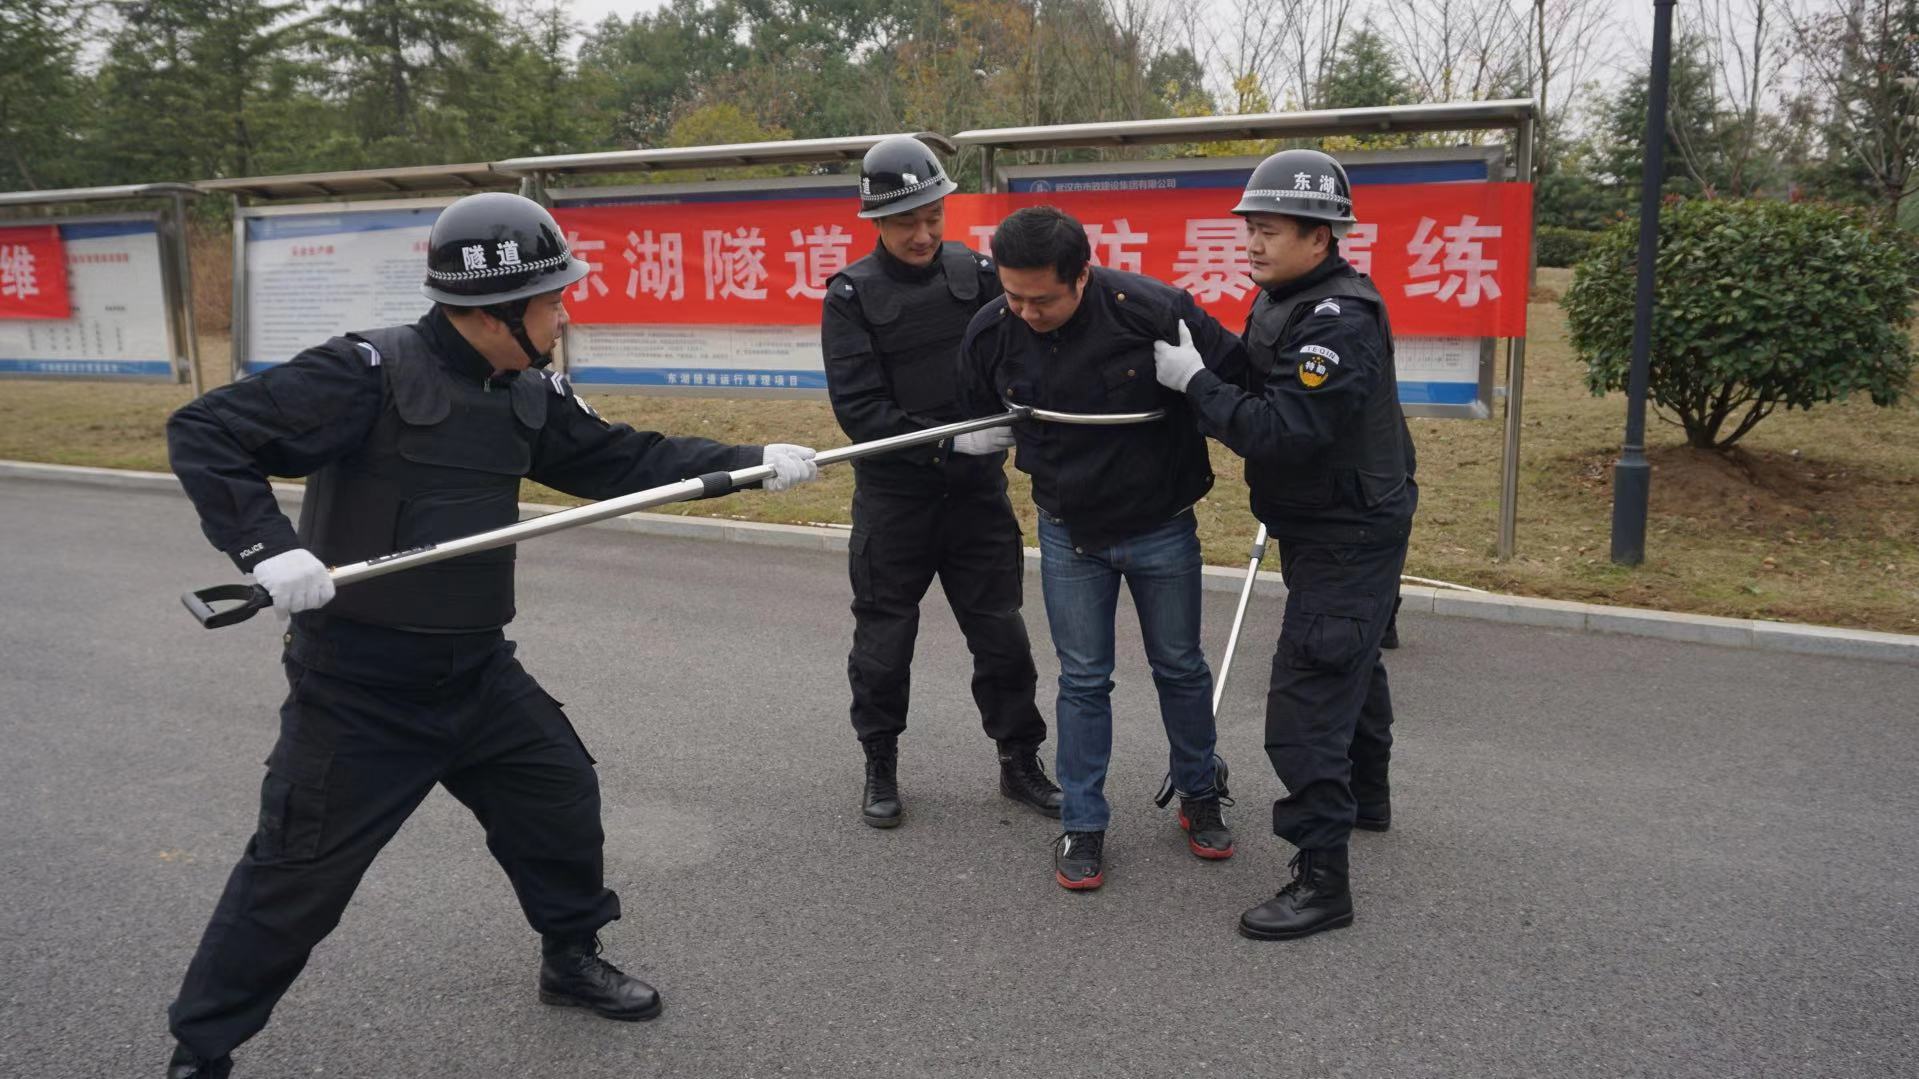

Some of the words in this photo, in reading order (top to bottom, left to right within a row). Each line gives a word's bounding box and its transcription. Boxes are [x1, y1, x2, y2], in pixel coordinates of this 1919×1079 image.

[1294, 172, 1335, 193] 东湖
[462, 240, 521, 270] 隧道
[667, 372, 799, 387] 东湖隧道运行管理项目
[239, 542, 264, 560] POLICE
